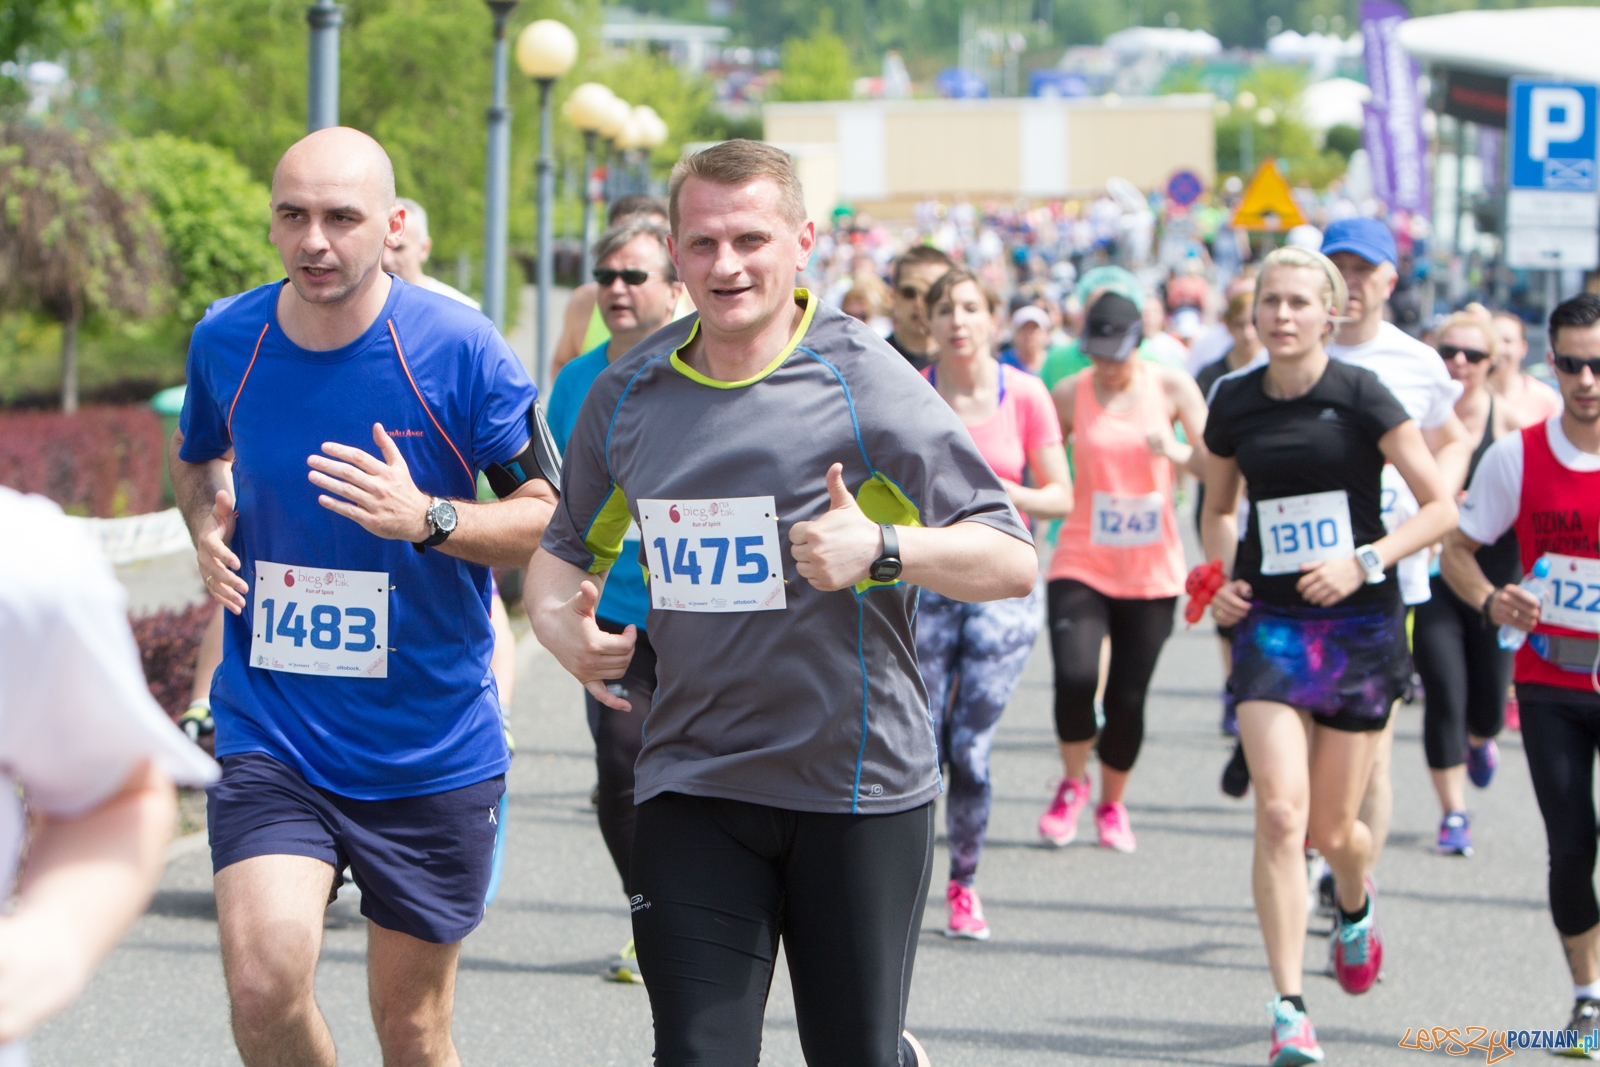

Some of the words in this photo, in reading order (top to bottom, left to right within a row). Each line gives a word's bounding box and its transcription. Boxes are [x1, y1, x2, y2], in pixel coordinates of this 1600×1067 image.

[1528, 88, 1585, 162] P
[1099, 509, 1158, 533] 1243
[1270, 518, 1338, 554] 1310
[653, 535, 769, 585] 1475
[261, 598, 376, 653] 1483
[631, 901, 651, 912] alenji
